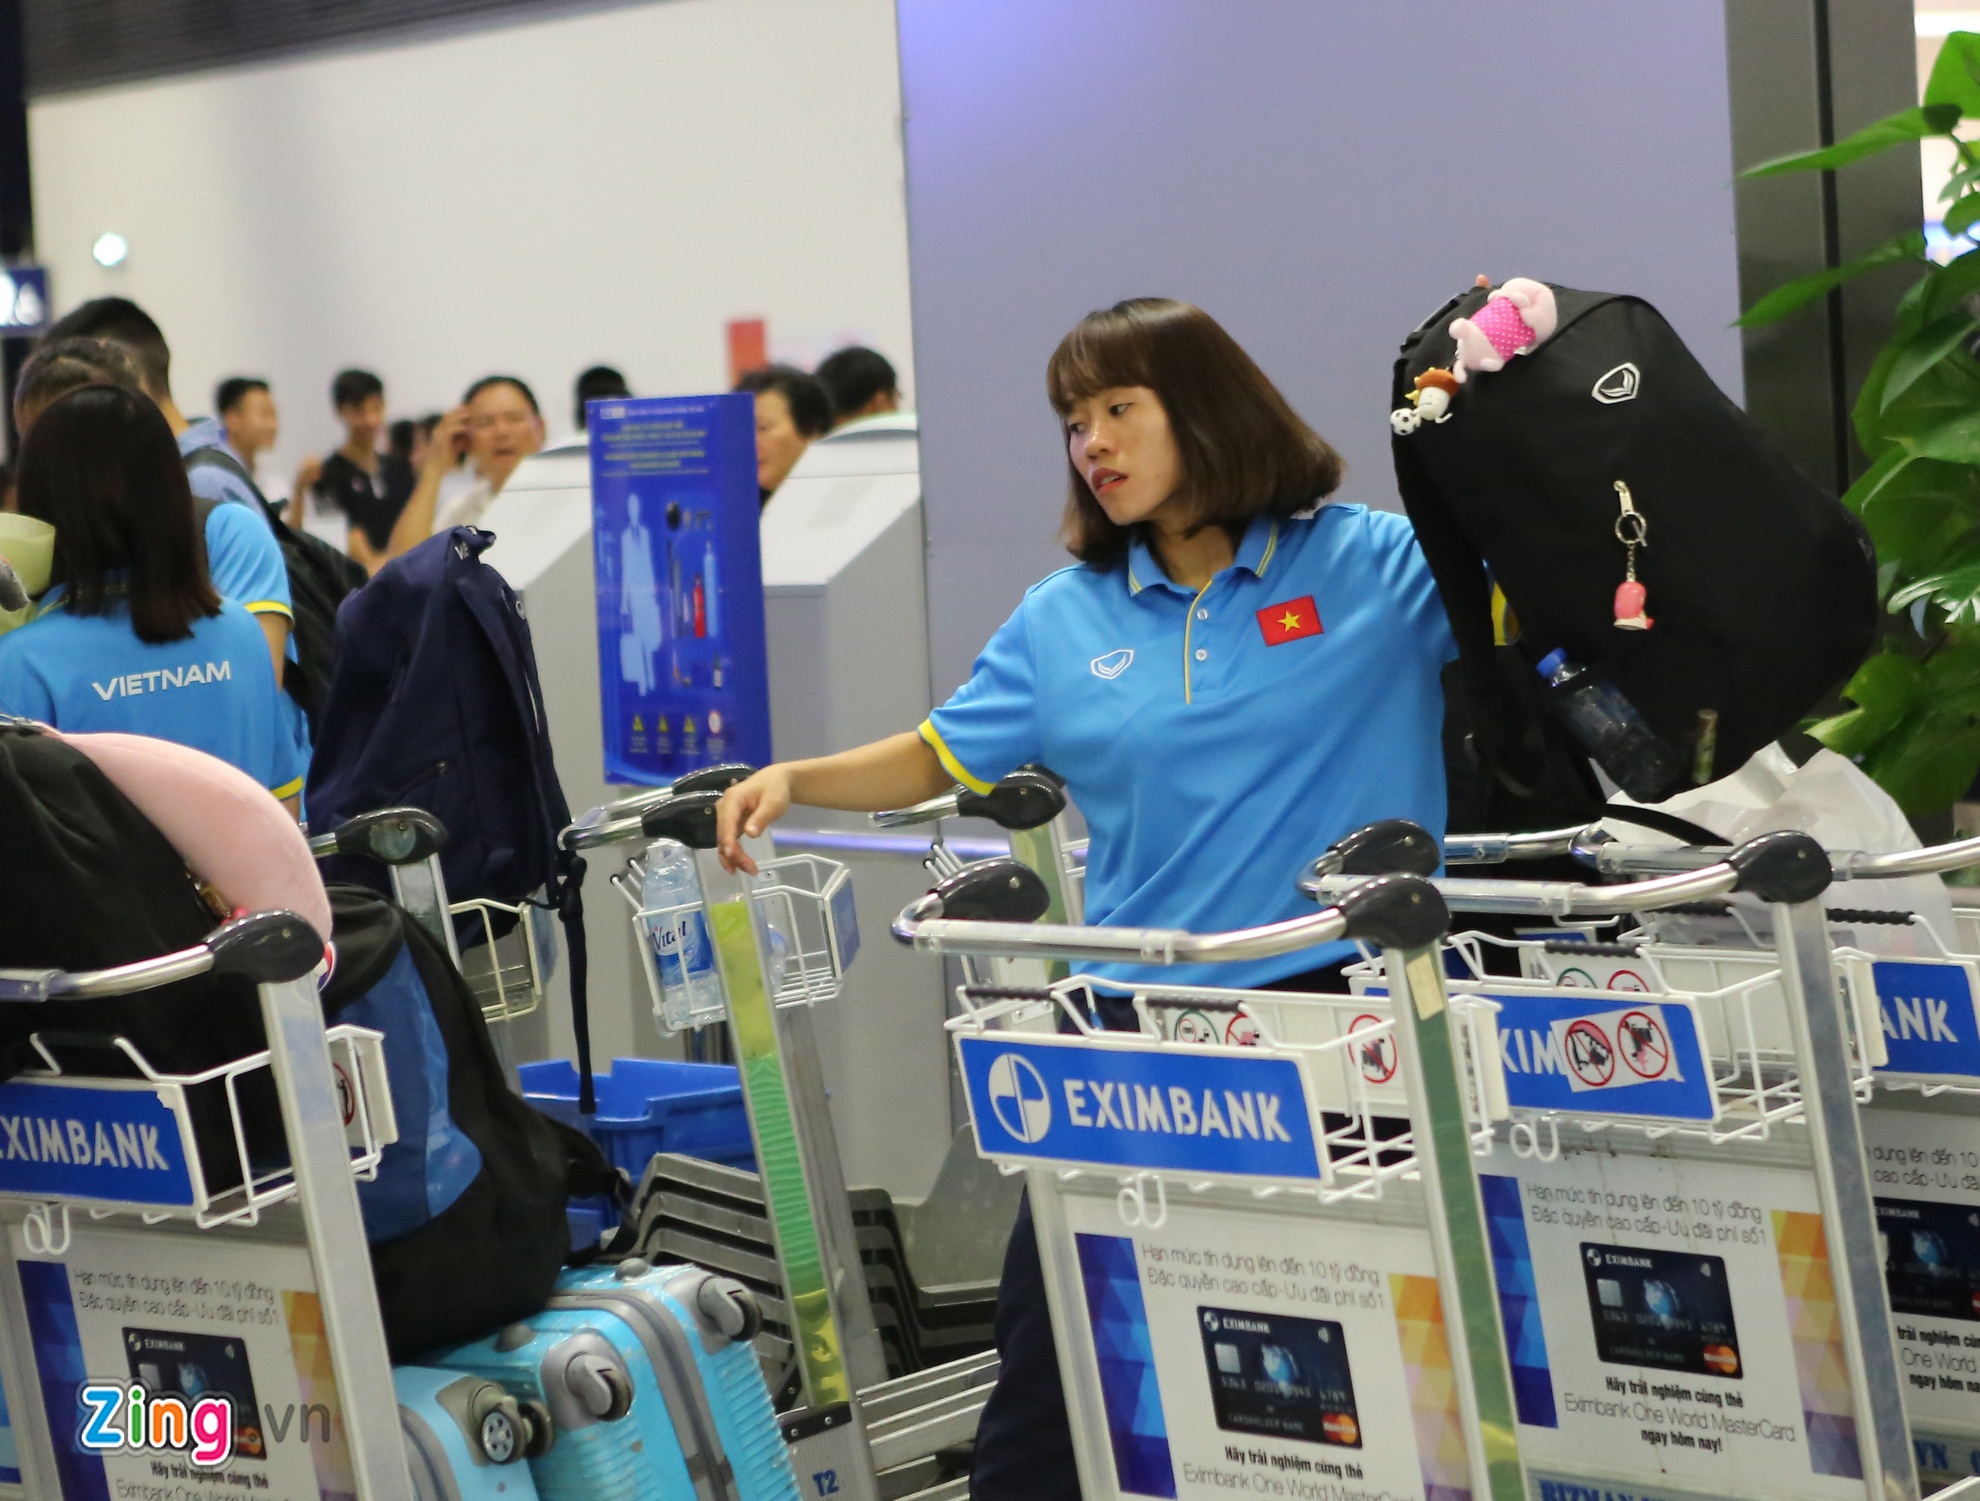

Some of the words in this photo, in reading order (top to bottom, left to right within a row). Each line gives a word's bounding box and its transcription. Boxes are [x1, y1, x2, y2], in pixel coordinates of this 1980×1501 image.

[91, 660, 232, 702] VIETNAM
[1063, 1078, 1292, 1143] EXIMBANK
[0, 1115, 170, 1171] XIMBANK
[1960, 1151, 1978, 1168] 10
[1692, 1198, 1710, 1216] 10
[1606, 1216, 1632, 1232] cao
[1309, 1259, 1327, 1280] 10
[1604, 1253, 1653, 1269] EXIMBANK
[214, 1279, 230, 1298] 10
[1222, 1278, 1248, 1295] cao
[1222, 1316, 1271, 1334] EXIMBANK
[1564, 1392, 1631, 1419] Eximbank
[1633, 1401, 1664, 1425] One
[1667, 1407, 1709, 1430] World
[1711, 1413, 1796, 1442] MasterCard
[1641, 1428, 1668, 1447] ngay
[1670, 1431, 1696, 1449] hôm
[1698, 1436, 1723, 1454] nay!
[812, 1469, 840, 1497] T2
[1183, 1463, 1249, 1490] Eximbank
[1252, 1472, 1284, 1495] One
[1286, 1478, 1329, 1501] World
